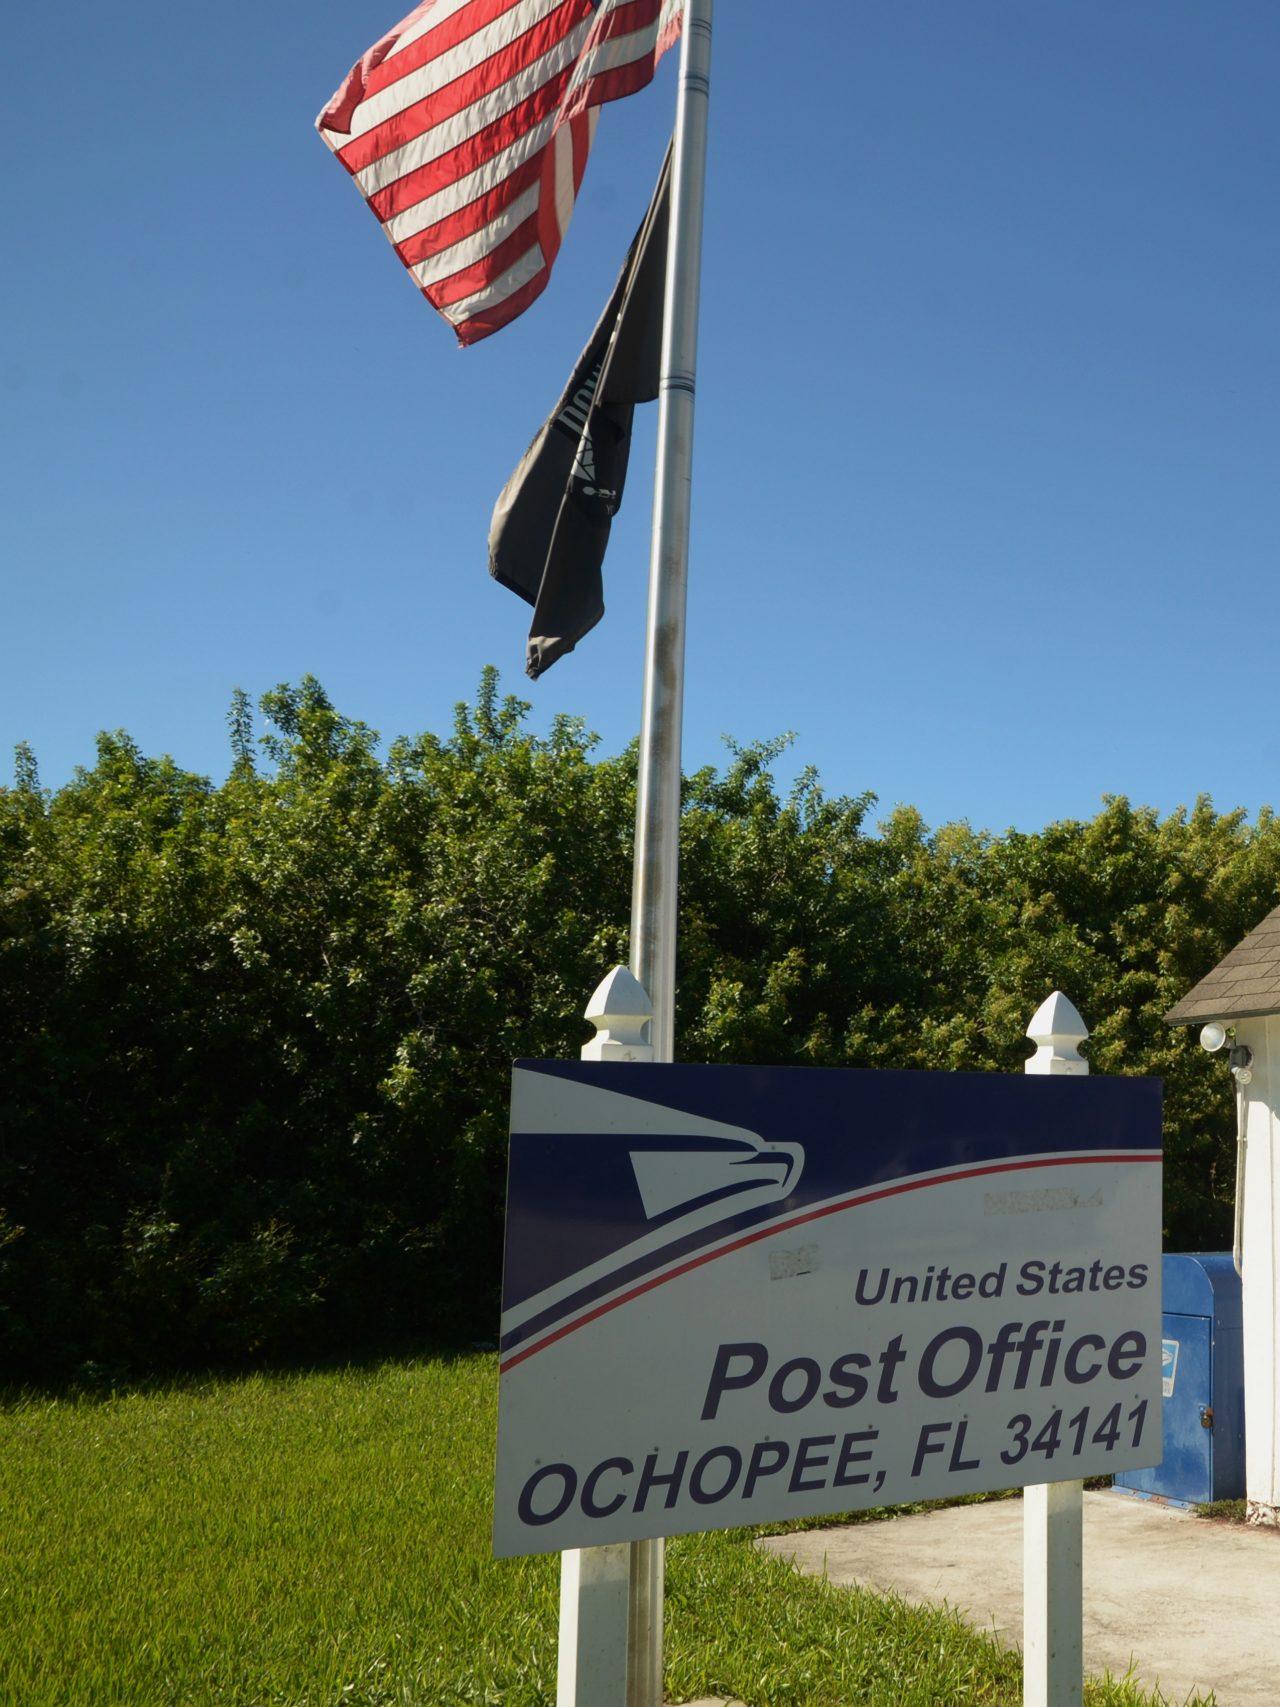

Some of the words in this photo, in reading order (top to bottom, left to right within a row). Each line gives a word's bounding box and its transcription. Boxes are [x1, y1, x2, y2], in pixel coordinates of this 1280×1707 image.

[855, 1263, 1008, 1306] United
[1016, 1259, 1149, 1299] States
[699, 1333, 908, 1421] Post
[917, 1319, 1149, 1399] Office
[517, 1429, 888, 1527] OCHOPEE,
[910, 1420, 981, 1478] FL
[999, 1399, 1149, 1466] 34141
